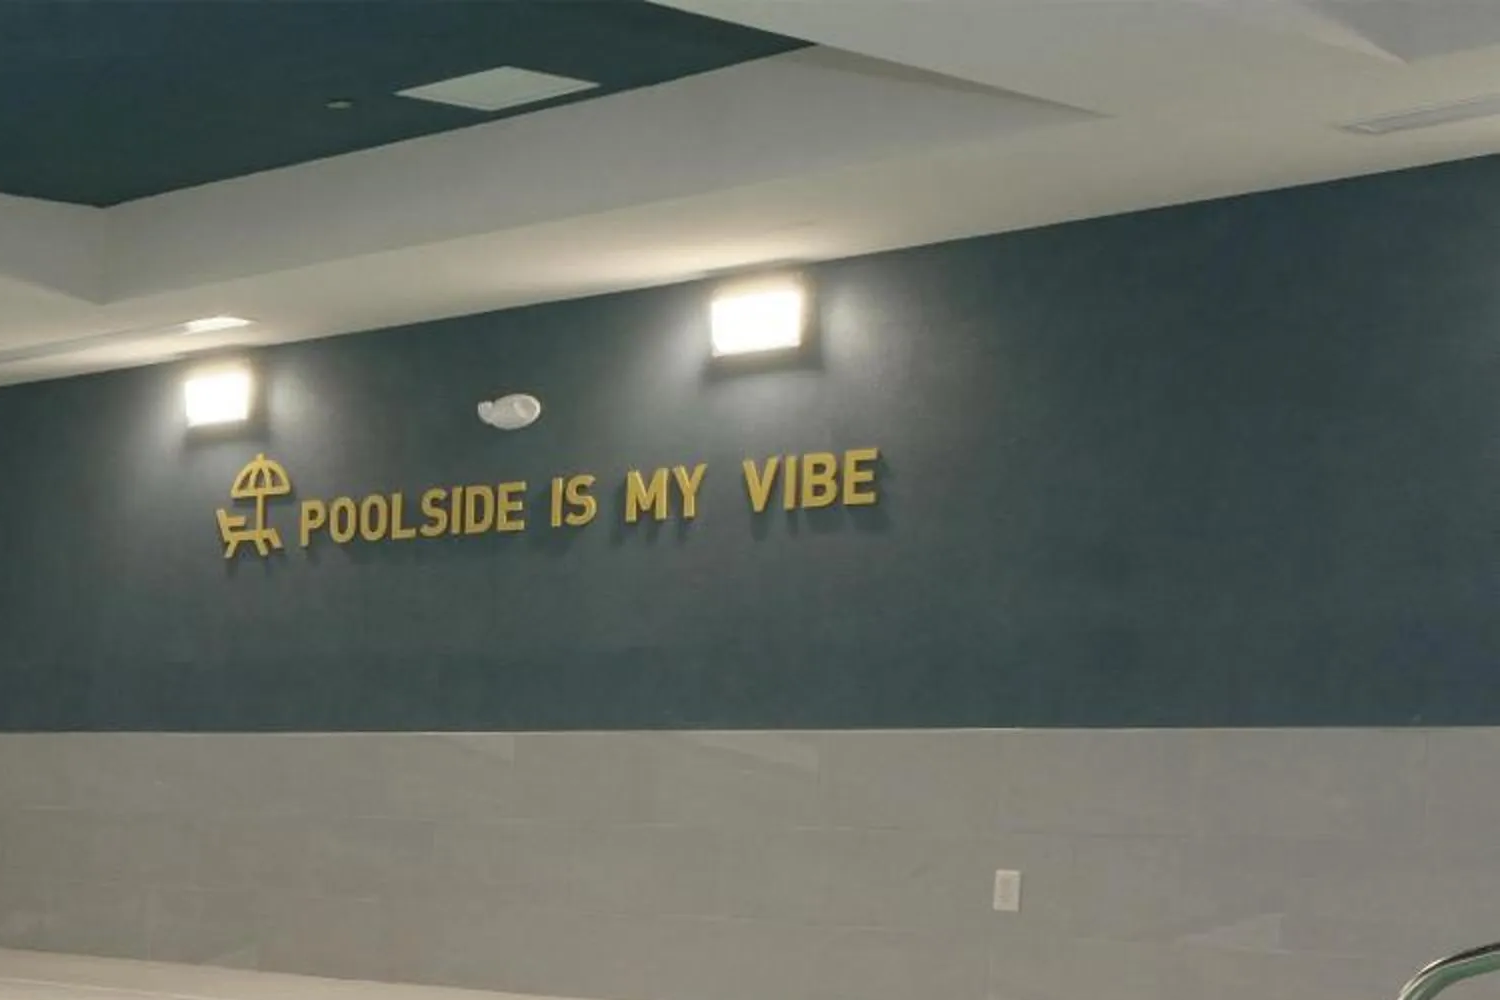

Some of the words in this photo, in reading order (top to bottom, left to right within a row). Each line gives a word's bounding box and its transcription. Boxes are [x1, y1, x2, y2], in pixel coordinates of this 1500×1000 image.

[300, 481, 526, 547] POOLSIDE
[550, 475, 598, 527] IS
[625, 464, 707, 523] MY
[743, 448, 879, 513] VIBE
